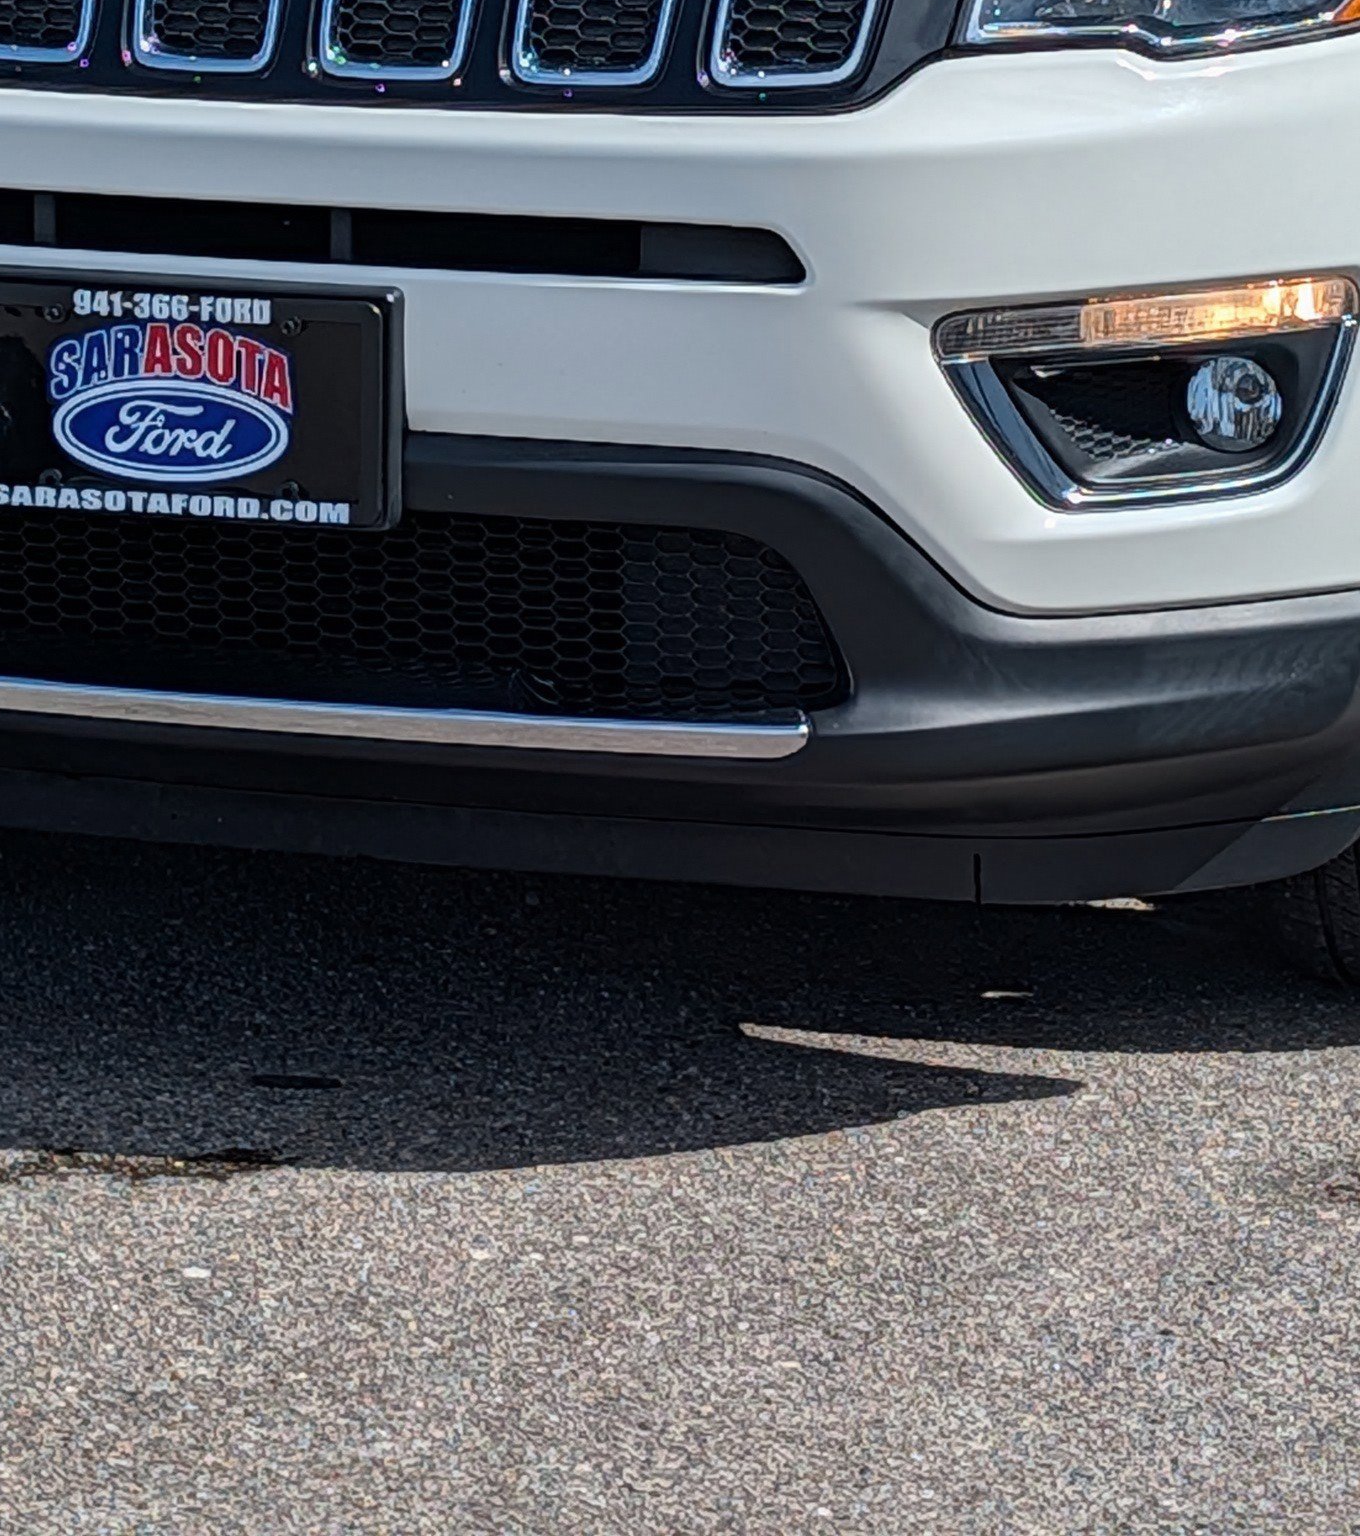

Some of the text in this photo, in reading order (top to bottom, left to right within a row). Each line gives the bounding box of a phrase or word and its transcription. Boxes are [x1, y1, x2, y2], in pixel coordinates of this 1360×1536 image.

[73, 289, 271, 324] 941-366-FORD
[50, 323, 293, 414] SARASOTA
[104, 400, 236, 459] Ford
